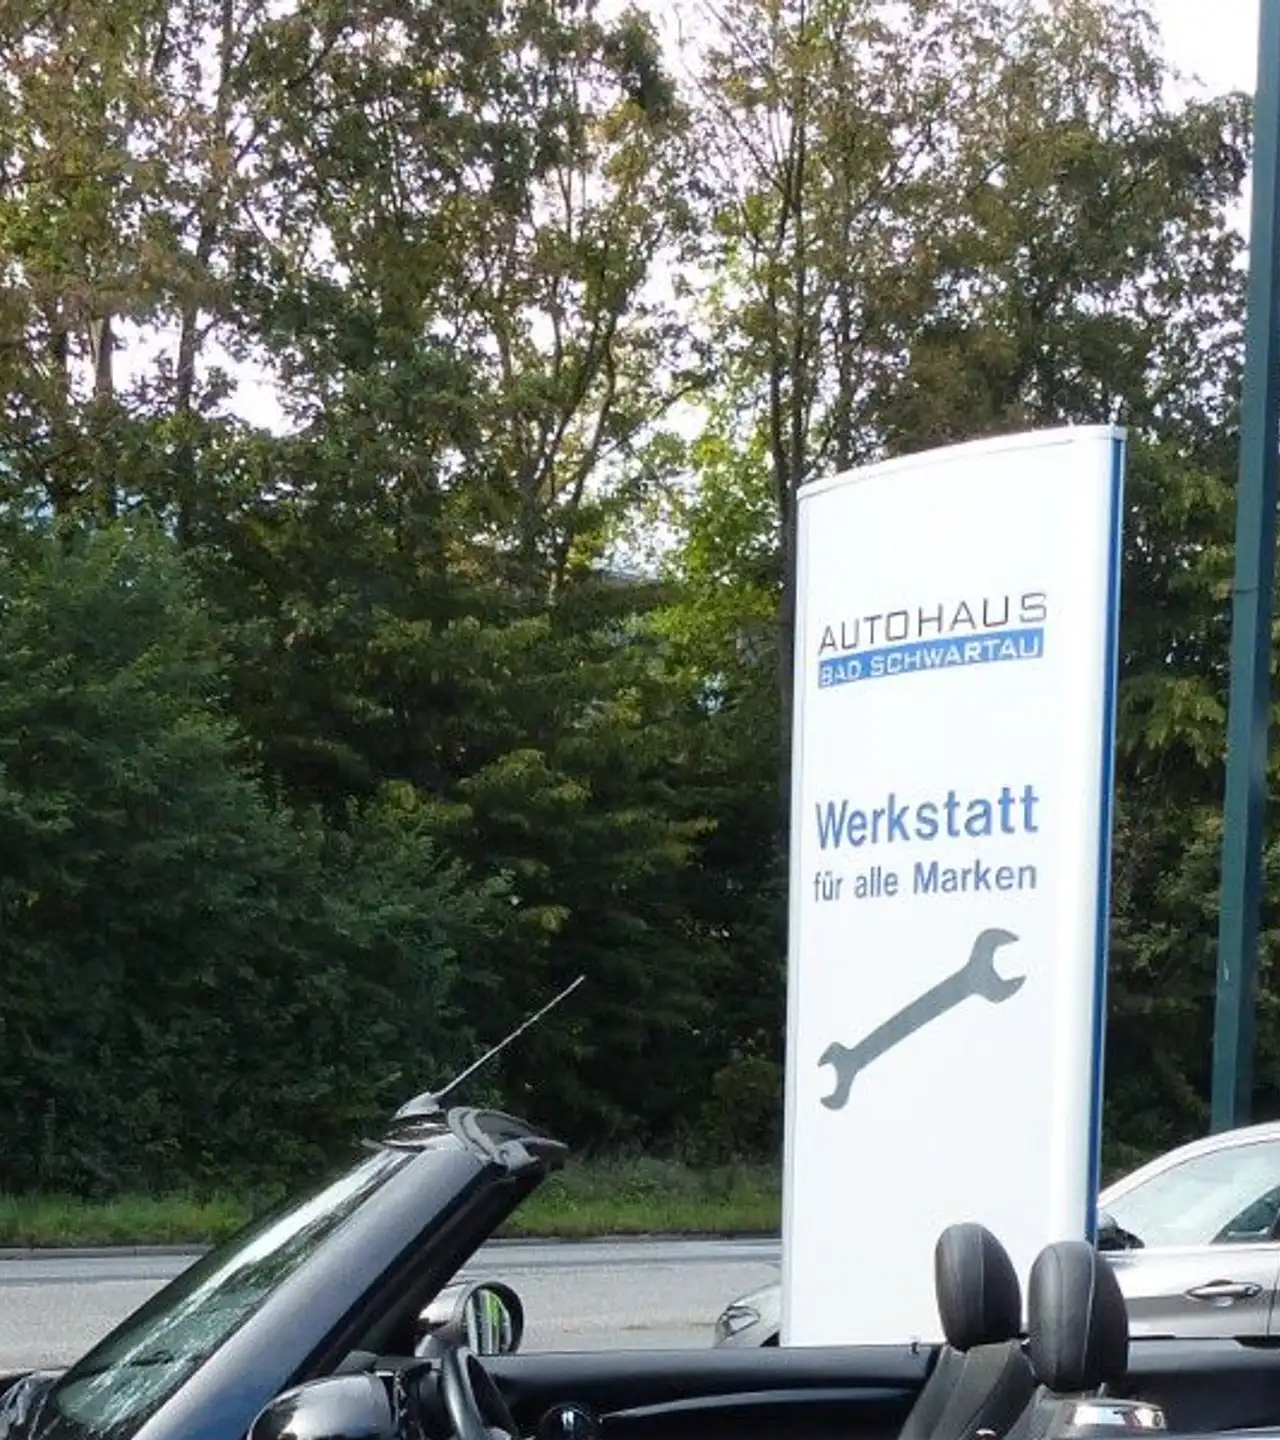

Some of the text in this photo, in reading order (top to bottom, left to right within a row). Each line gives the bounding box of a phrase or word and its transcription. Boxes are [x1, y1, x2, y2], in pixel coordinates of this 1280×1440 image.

[818, 592, 1048, 655] AUTOHAUS
[820, 635, 1041, 687] BAD SCHWARTAU
[815, 784, 1040, 851] Werkstatt
[813, 858, 1038, 902] für alle Marken
